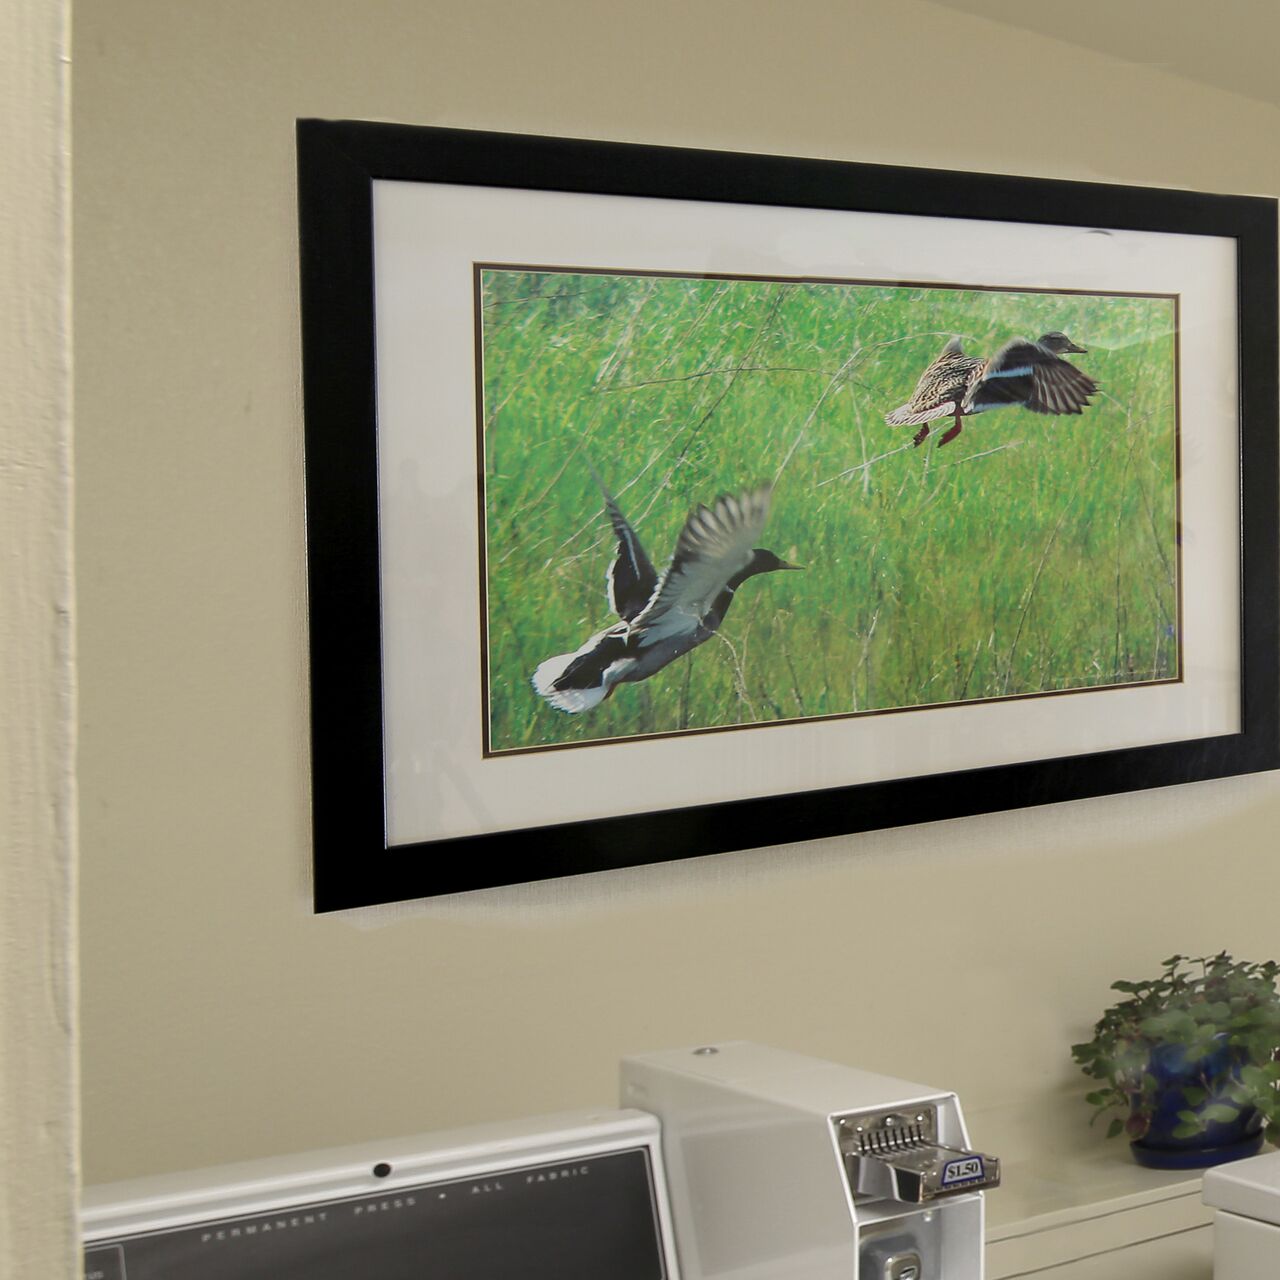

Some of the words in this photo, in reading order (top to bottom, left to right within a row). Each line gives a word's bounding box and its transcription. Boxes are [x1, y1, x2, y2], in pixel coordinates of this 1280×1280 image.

[947, 1161, 979, 1179] $1.50
[201, 1212, 329, 1243] PERMANENT
[353, 1197, 417, 1216] PRESS
[471, 1181, 503, 1195] ALL
[526, 1165, 589, 1184] FABRIC
